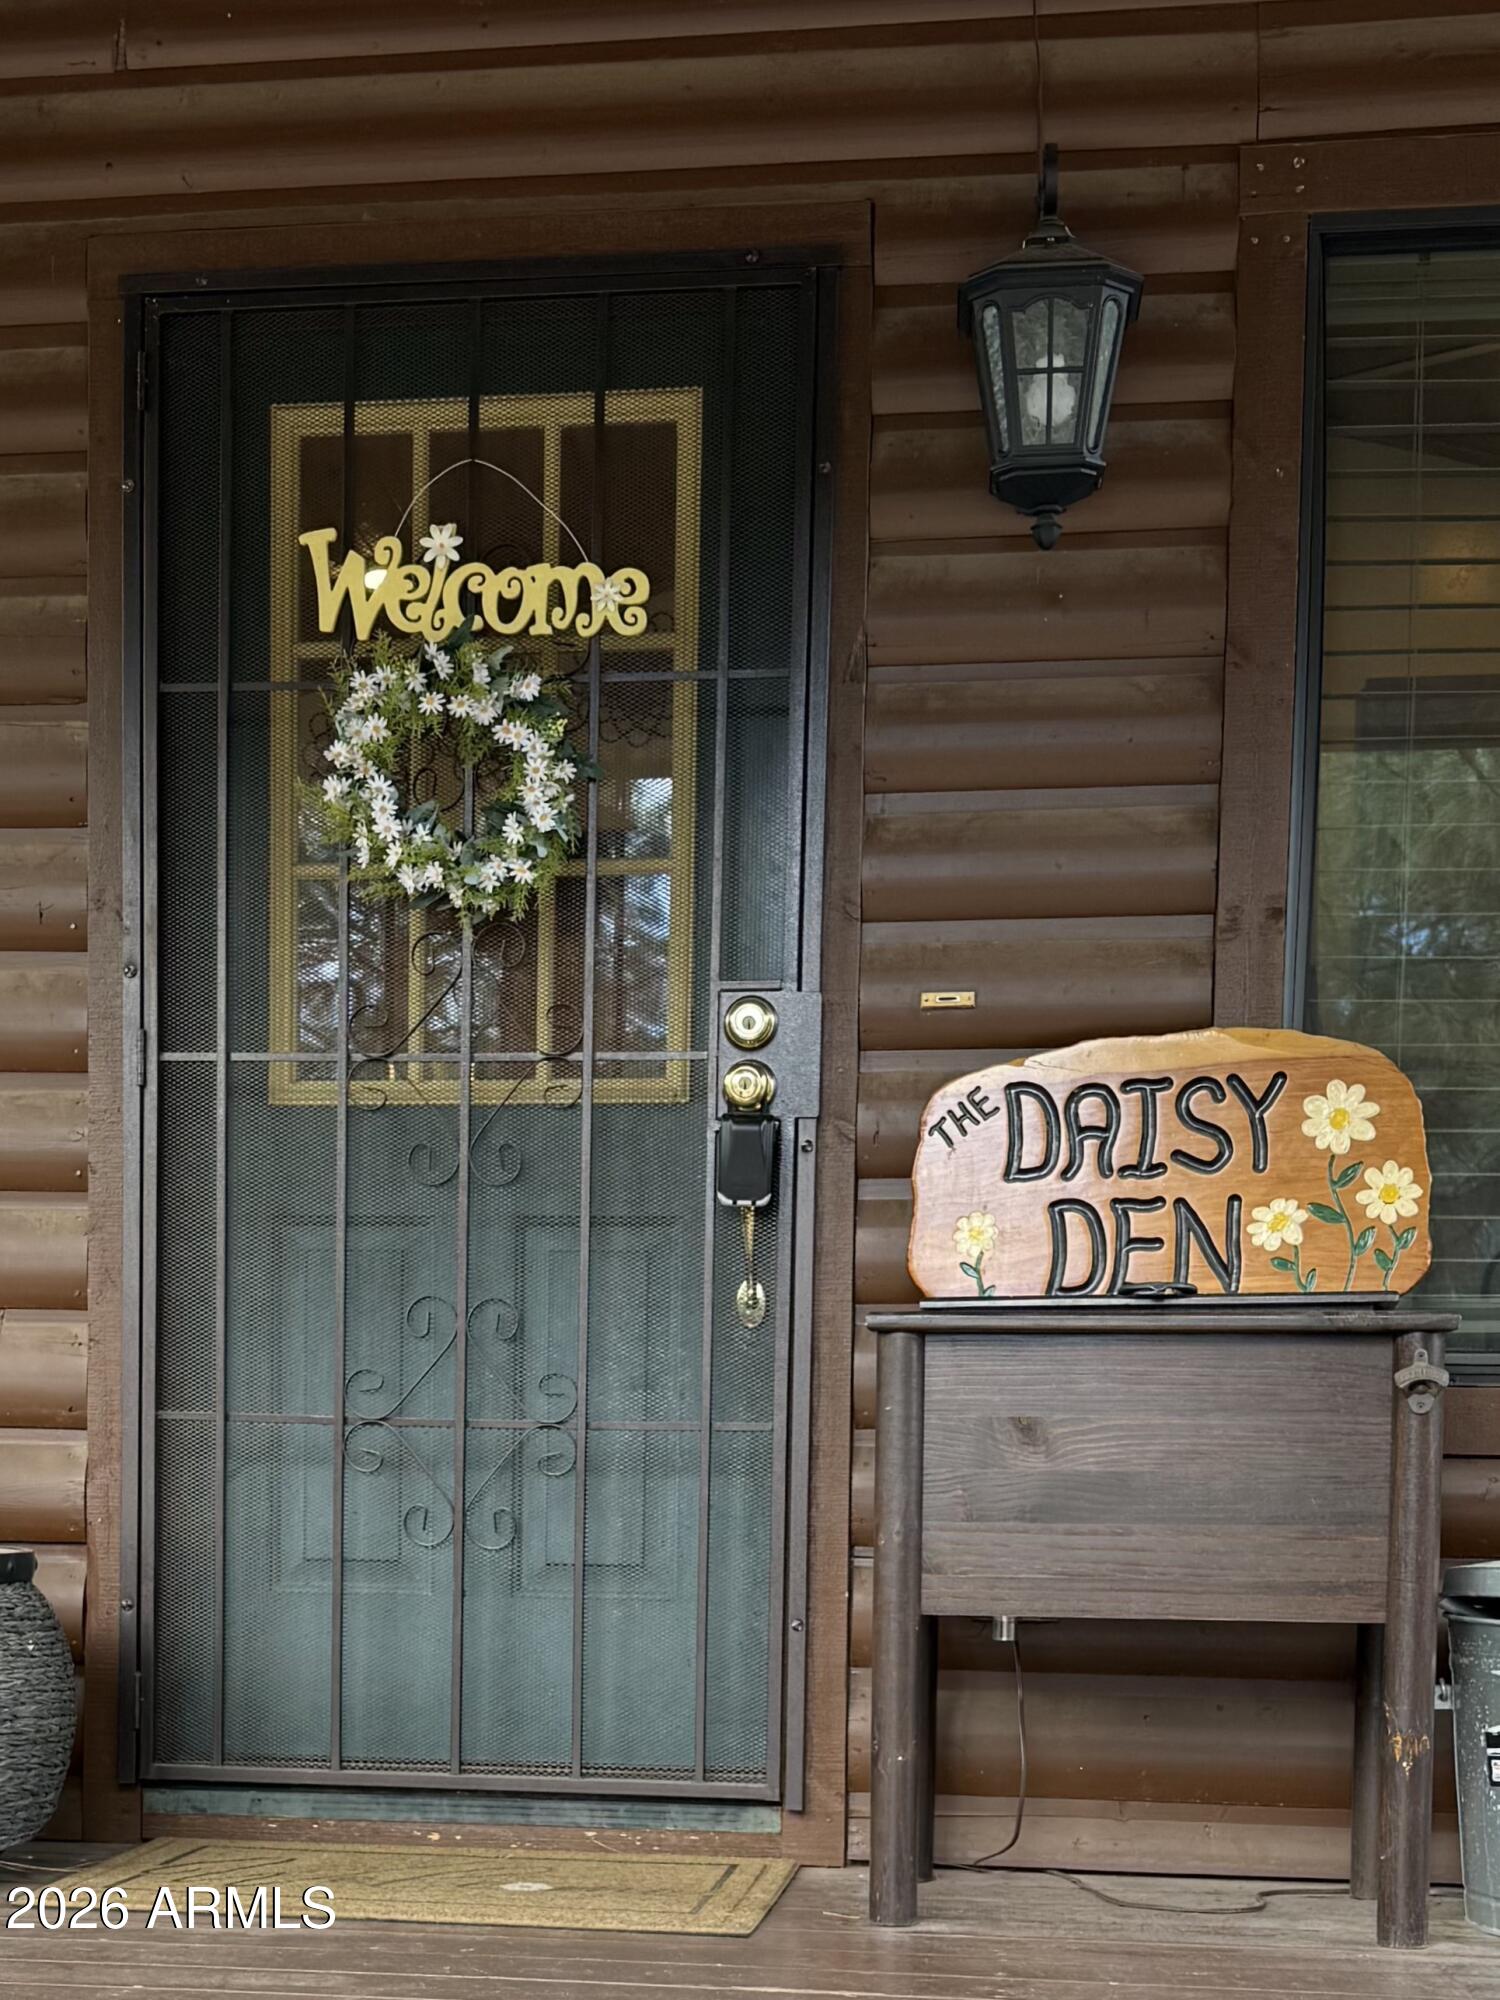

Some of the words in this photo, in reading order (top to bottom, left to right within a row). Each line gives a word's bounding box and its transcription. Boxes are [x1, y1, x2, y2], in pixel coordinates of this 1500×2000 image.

[299, 523, 650, 642] Welcome
[927, 1084, 1001, 1153] THE
[1003, 1070, 1288, 1184] DAISY
[1045, 1193, 1243, 1297] DEN
